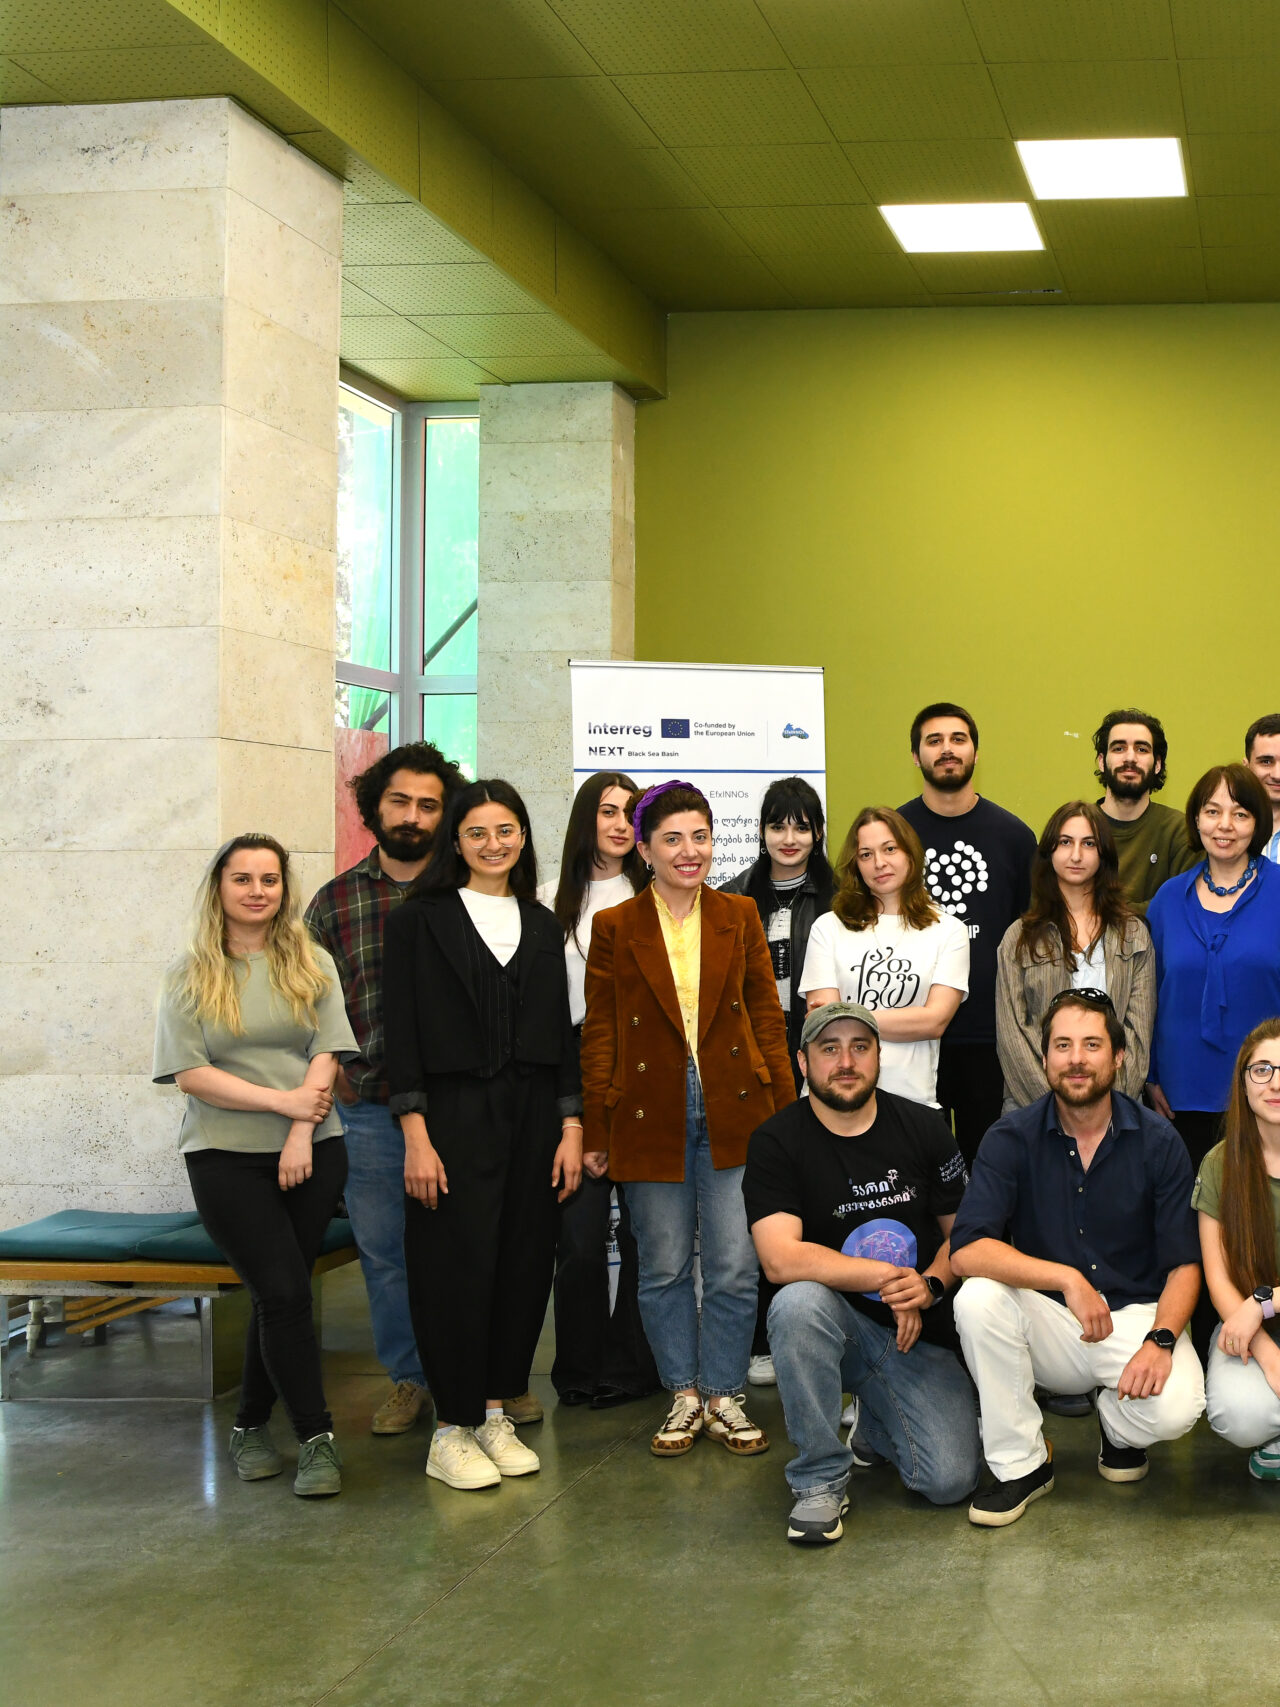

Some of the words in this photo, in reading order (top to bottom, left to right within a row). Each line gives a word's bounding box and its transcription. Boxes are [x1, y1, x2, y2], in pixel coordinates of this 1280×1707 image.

[588, 722, 652, 738] Interreg
[694, 721, 726, 729] Co-funded
[728, 722, 736, 730] by
[705, 730, 736, 738] European
[588, 746, 625, 757] NEXT
[709, 790, 749, 799] EfxINNOs
